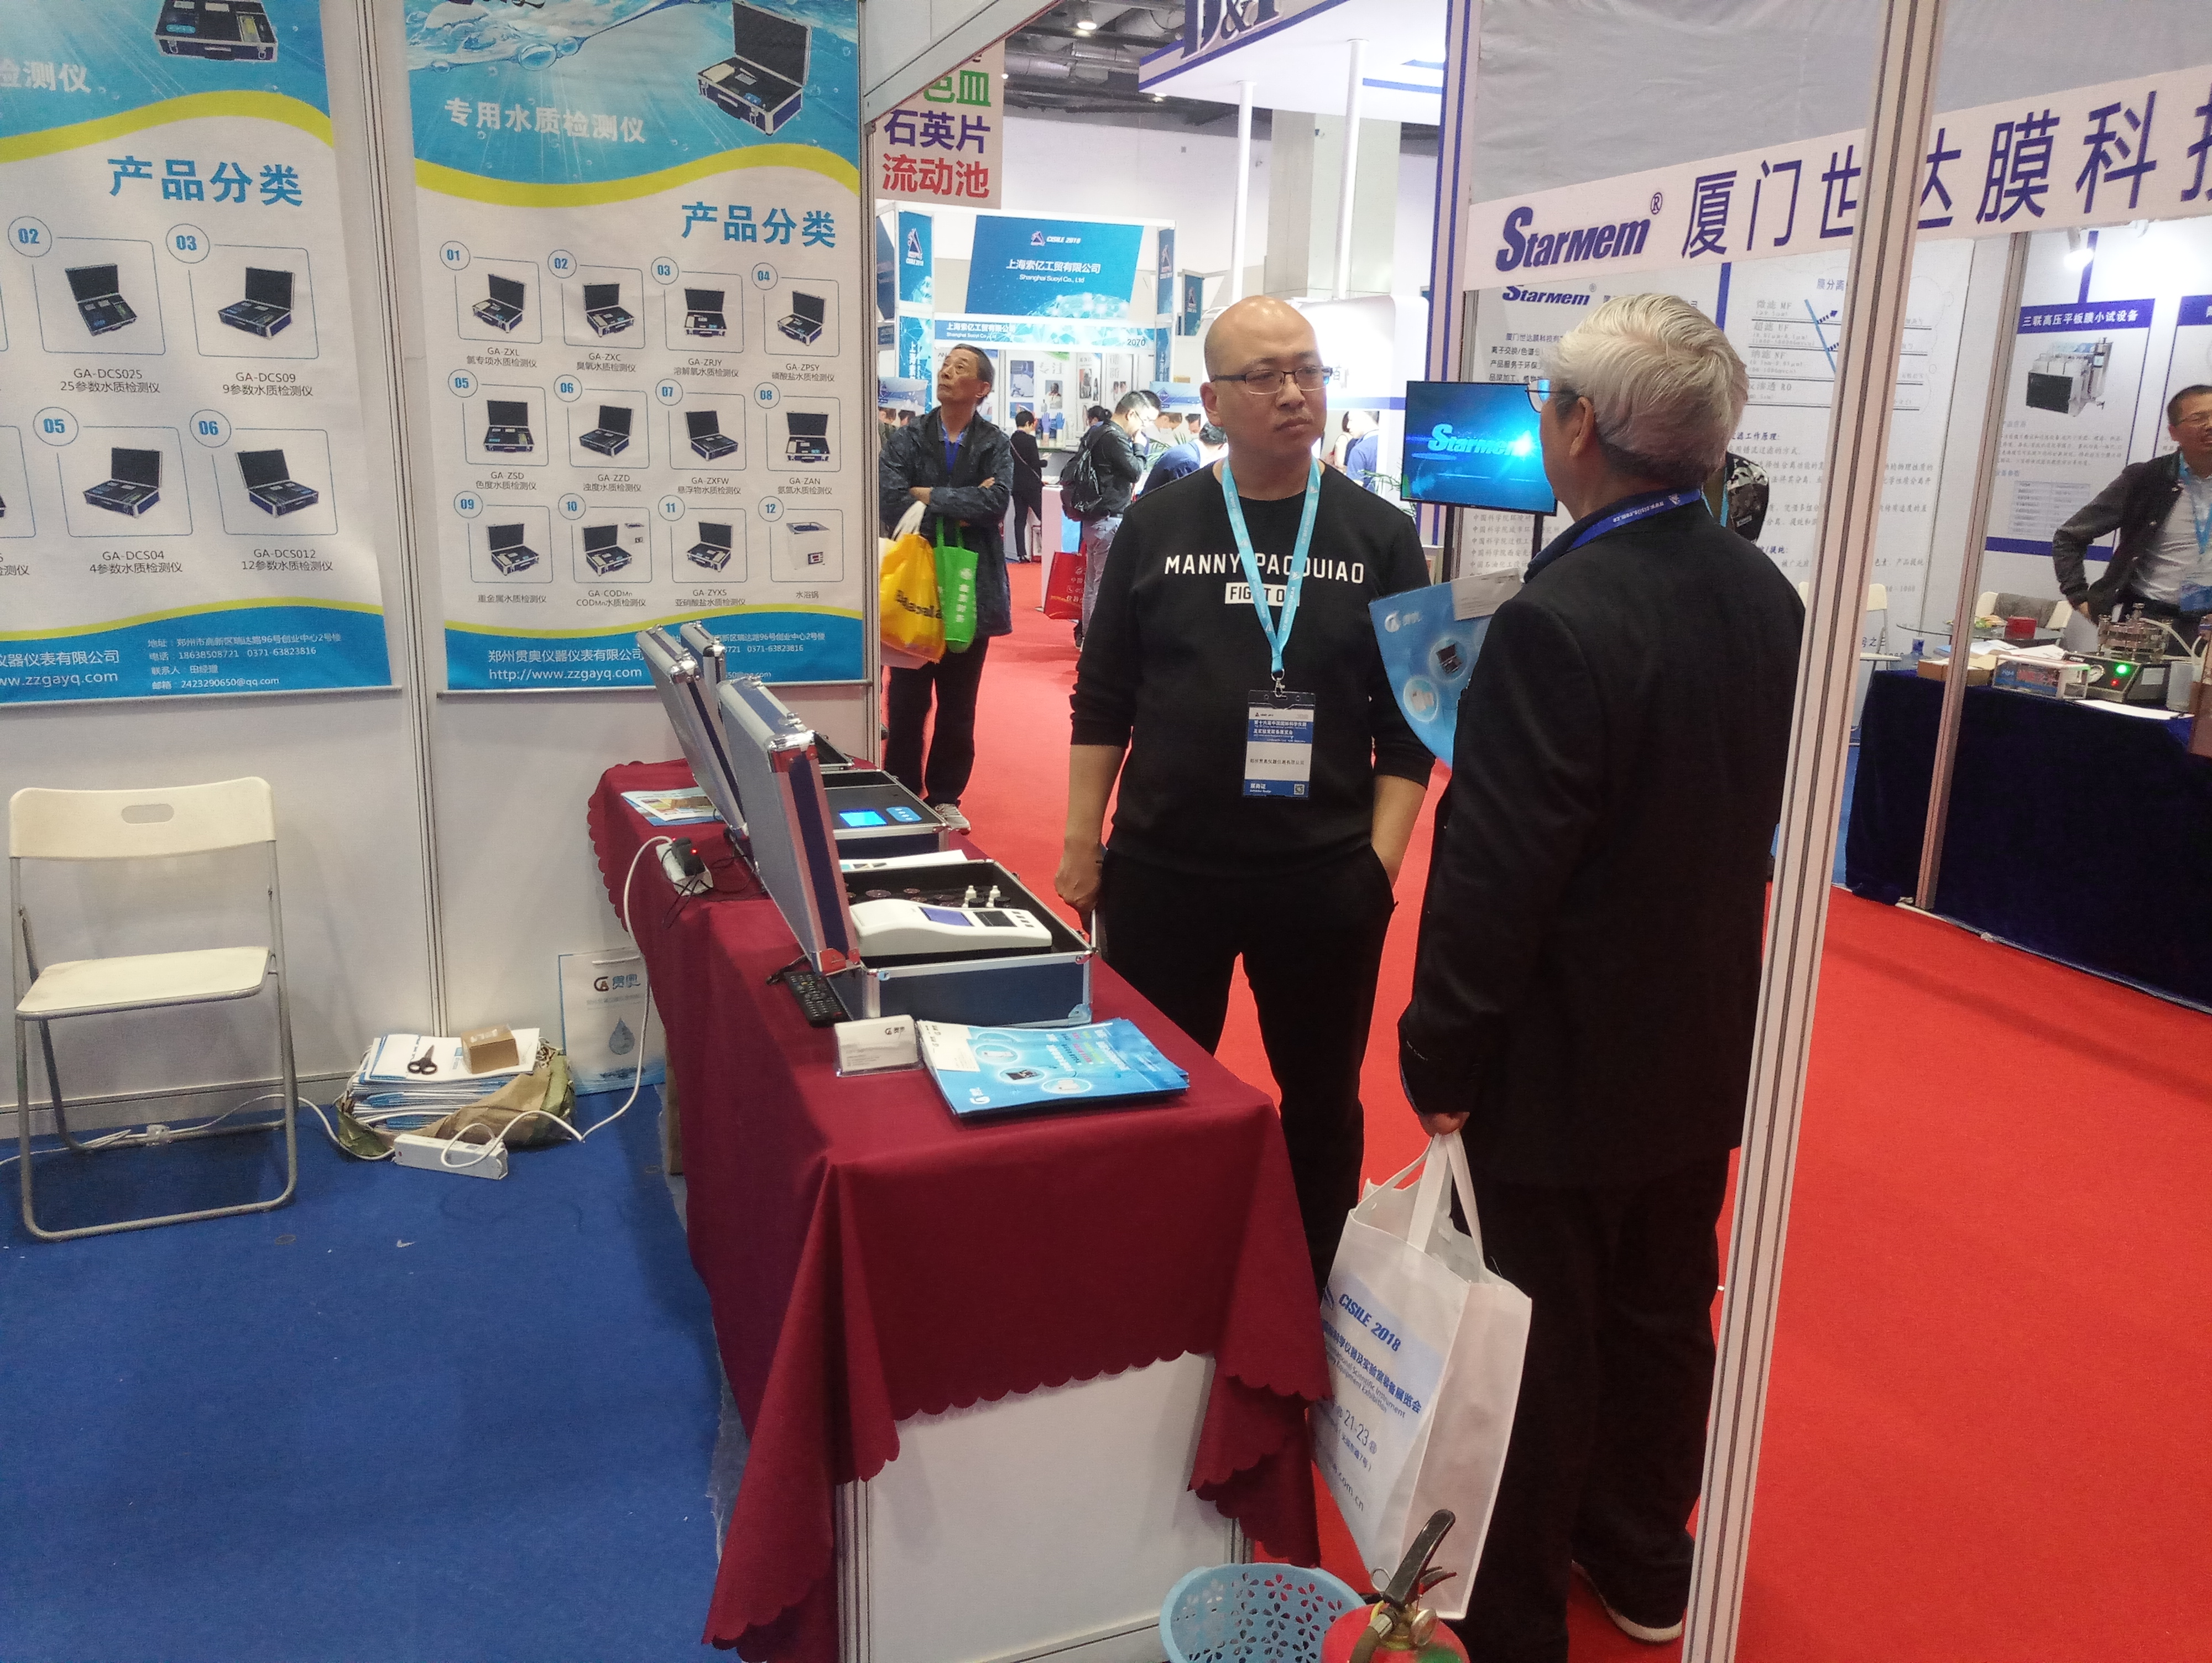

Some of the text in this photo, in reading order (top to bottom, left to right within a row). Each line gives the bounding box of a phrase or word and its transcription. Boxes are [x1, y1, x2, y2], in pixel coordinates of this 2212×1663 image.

[445, 97, 646, 144] 专用水质检测仪
[883, 109, 990, 154] 石英片
[107, 155, 303, 206] 产品分类
[883, 153, 989, 198] 流动池
[681, 201, 836, 248] 产品分类
[18, 228, 40, 245] 02
[175, 235, 197, 251] 03
[446, 249, 460, 261] 01
[554, 258, 568, 270] 02
[657, 265, 671, 276] 03
[757, 270, 770, 281] 04
[487, 347, 520, 357] GA-ZXL
[588, 353, 621, 362] GA-ZXC
[688, 358, 722, 367] GA-ZRJY
[74, 369, 143, 380] GA-DCS025
[236, 373, 296, 383] GA-DCS09
[60, 381, 160, 394] 25参数水质检测仪
[455, 377, 469, 388] 05
[560, 383, 574, 393] 06
[223, 384, 313, 397] 9参数水质检测仪
[661, 386, 674, 397] 07
[760, 390, 773, 400] 08
[43, 419, 65, 434] 05
[199, 421, 219, 436] 06
[491, 471, 524, 479] GA-ZSD
[597, 474, 630, 482] GA-ZZD
[476, 480, 536, 491] 色度水质检测仪
[460, 498, 474, 510] 09
[565, 501, 577, 512] 10
[665, 503, 675, 513] 11
[765, 504, 776, 514] 12
[102, 551, 165, 561] GA-DCS04
[254, 549, 316, 559] GA-DCS012
[90, 561, 182, 574] 4参数水质检测仪
[242, 560, 333, 572] 12参数水质检测仪
[1164, 553, 1240, 575] MANNY
[795, 590, 819, 599] 水浴锅
[1229, 585, 1271, 602] FIGT
[488, 647, 644, 663] 郑州贯奥仪器仪表有限公司
[489, 666, 643, 681] http://www.zzgayq.com
[1338, 1293, 1401, 1352] CISILE 2018
